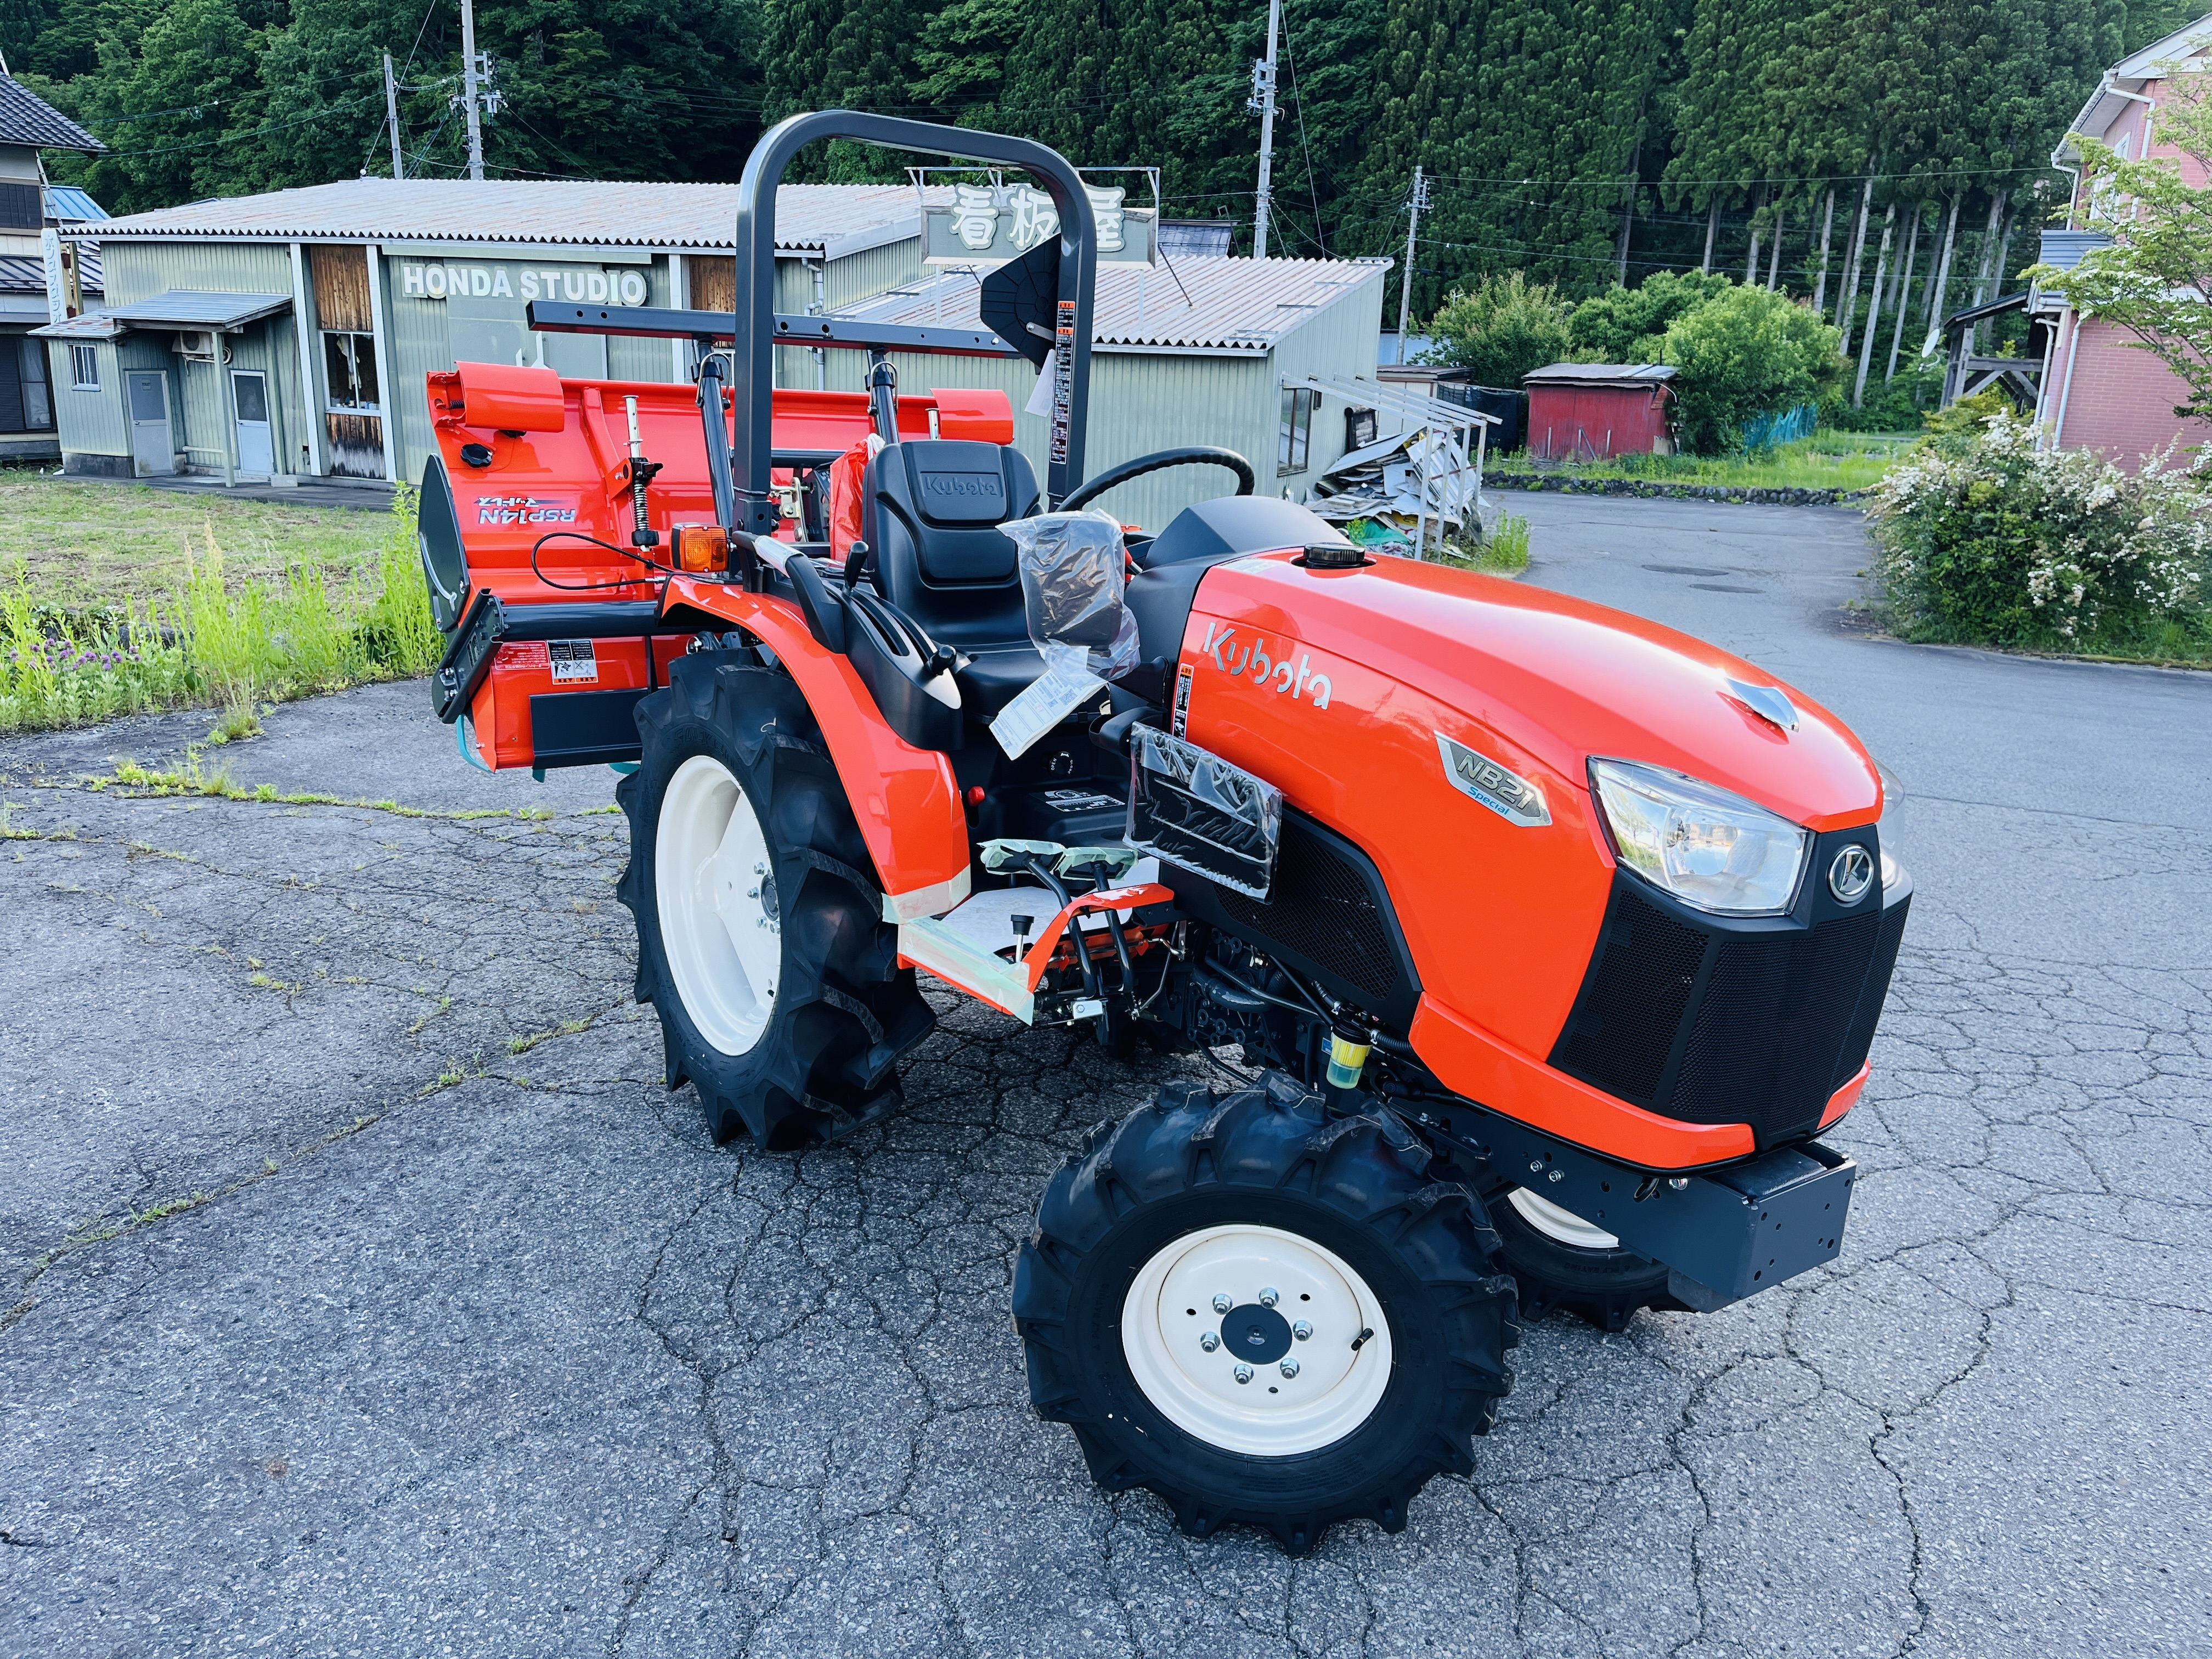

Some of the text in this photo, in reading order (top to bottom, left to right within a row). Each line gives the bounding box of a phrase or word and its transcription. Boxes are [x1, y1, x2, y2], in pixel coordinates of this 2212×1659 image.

[952, 185, 1122, 249] 看板屋
[403, 266, 645, 304] HONDA STUDIO
[478, 496, 540, 507] マッドレス
[925, 476, 998, 496] Kubota
[478, 508, 576, 525] RSP14N
[1203, 622, 1333, 711] Kubota
[1457, 754, 1535, 810] NB21
[1468, 786, 1510, 815] Special
